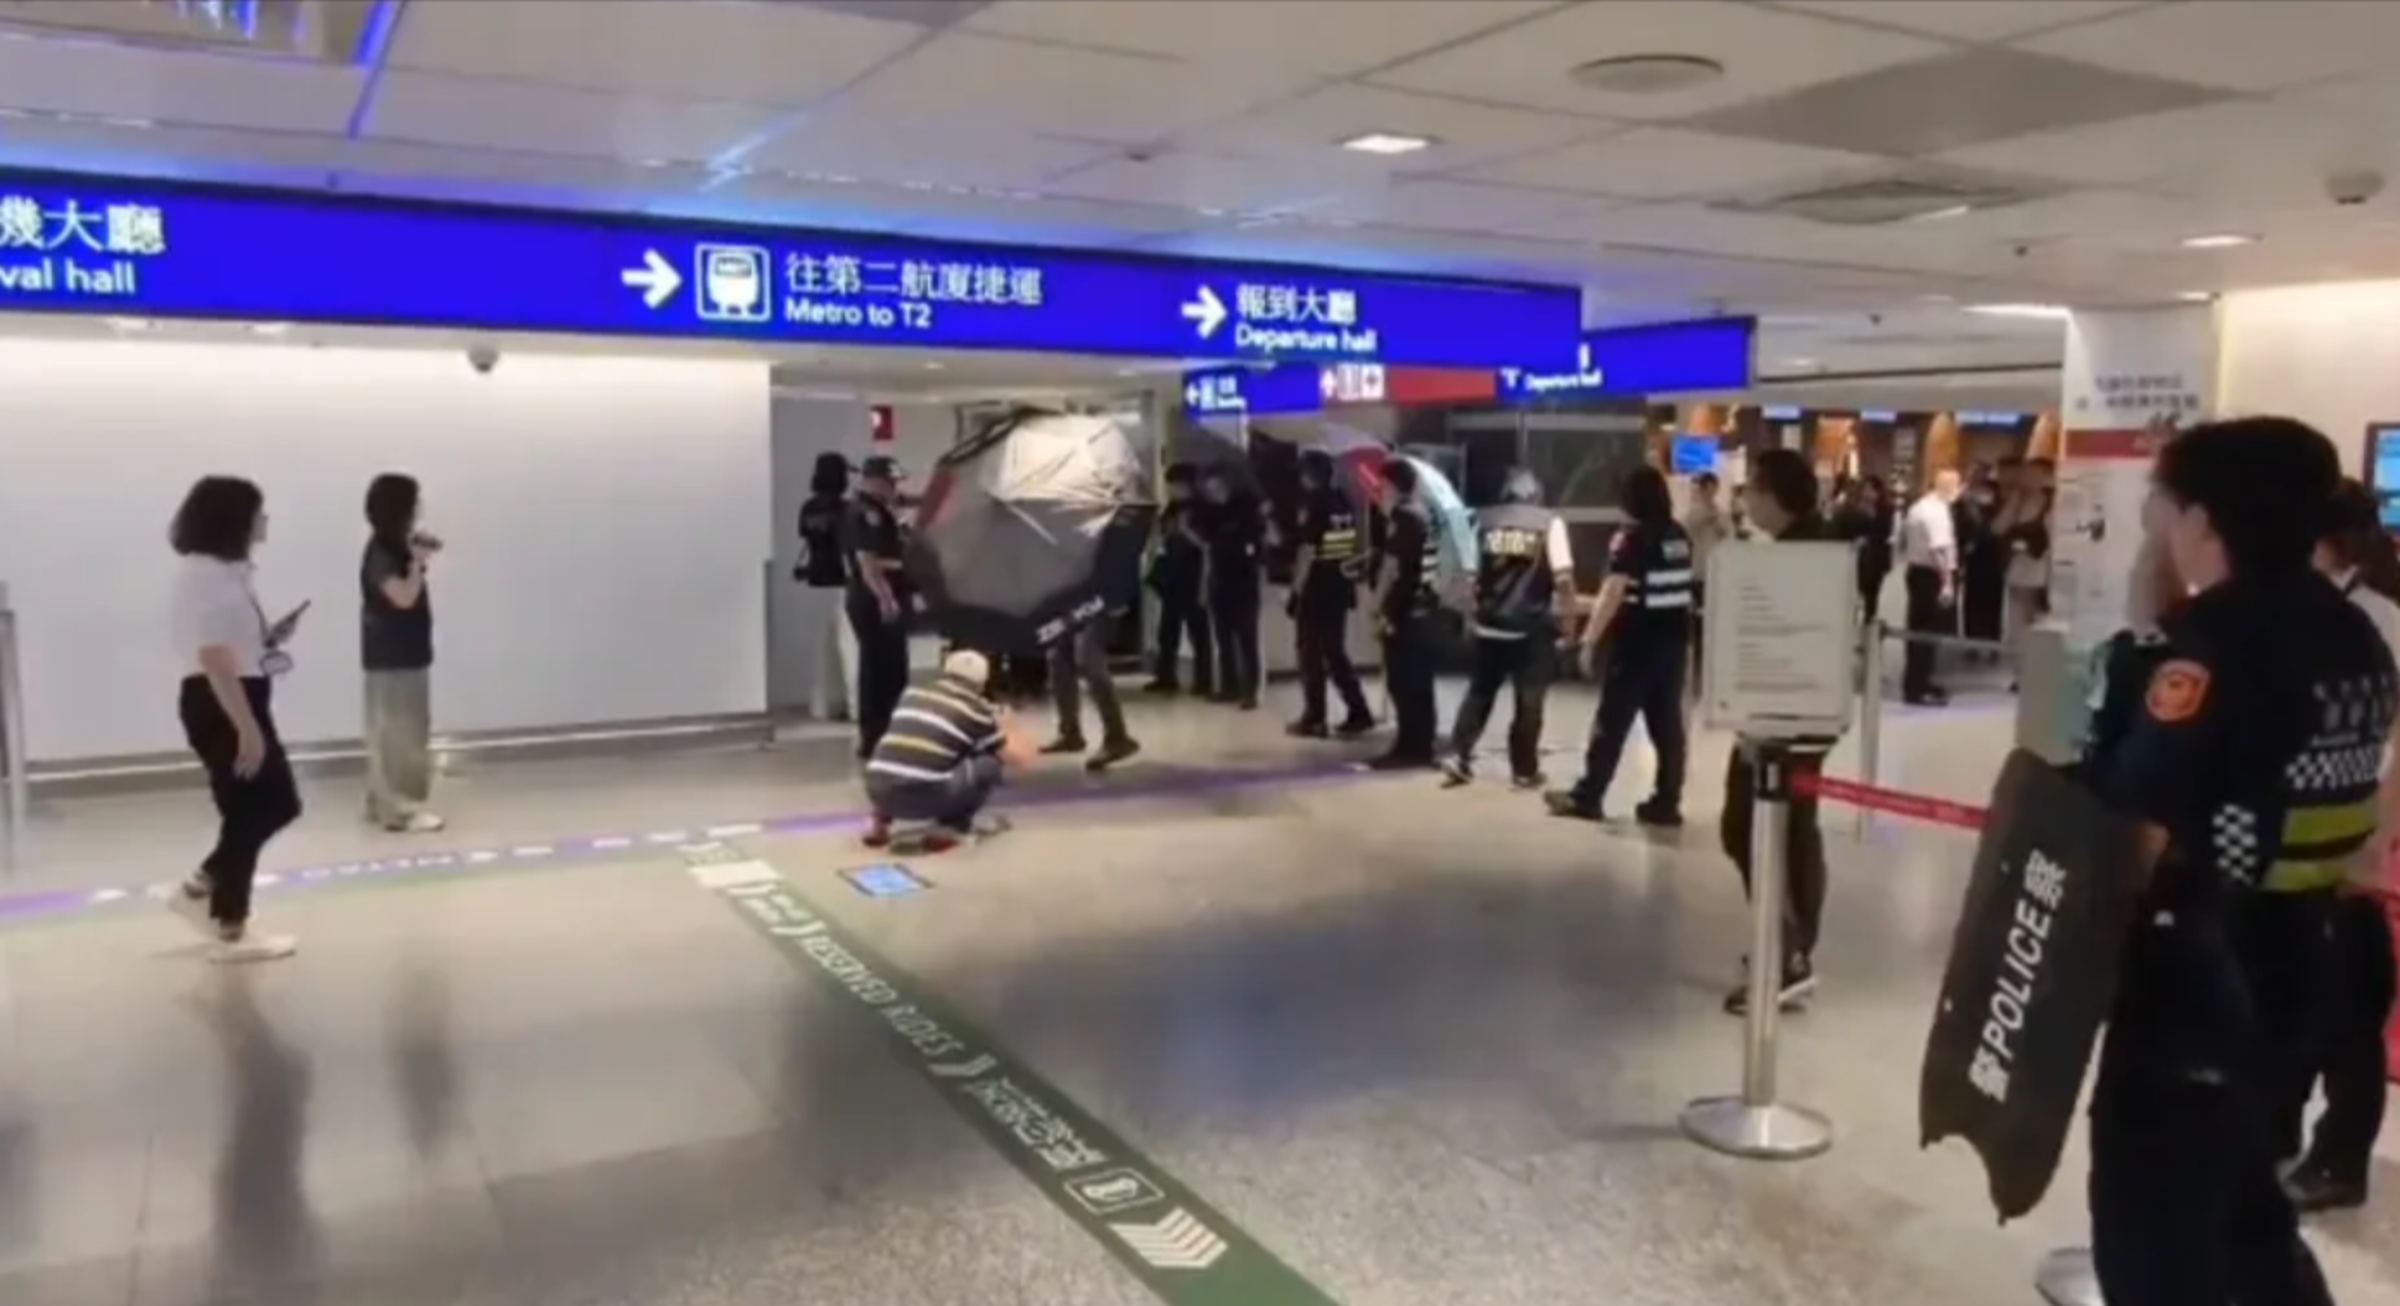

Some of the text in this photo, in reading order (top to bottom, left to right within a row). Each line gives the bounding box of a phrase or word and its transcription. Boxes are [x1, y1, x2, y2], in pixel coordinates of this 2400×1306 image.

[65, 258, 136, 294] hall
[785, 297, 932, 328] Metro to T2
[1235, 321, 1377, 354] Departure hall
[800, 935, 965, 1056] RESERVED RIDES
